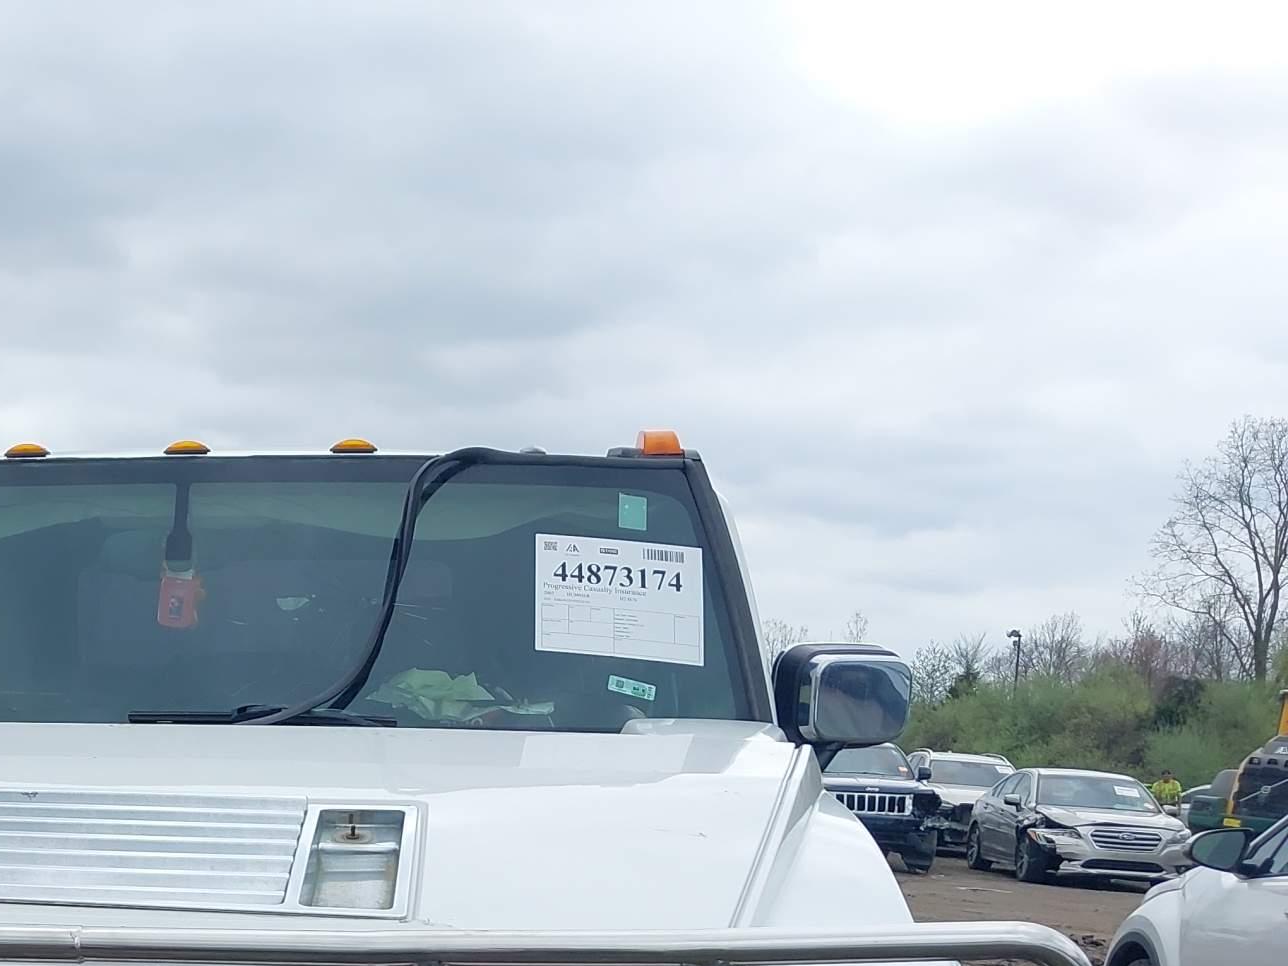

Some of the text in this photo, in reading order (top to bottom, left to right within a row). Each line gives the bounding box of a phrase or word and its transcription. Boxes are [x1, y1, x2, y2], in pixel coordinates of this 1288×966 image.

[553, 561, 683, 592] 44873174
[543, 581, 583, 592] Progressive
[583, 585, 613, 595] Casualty
